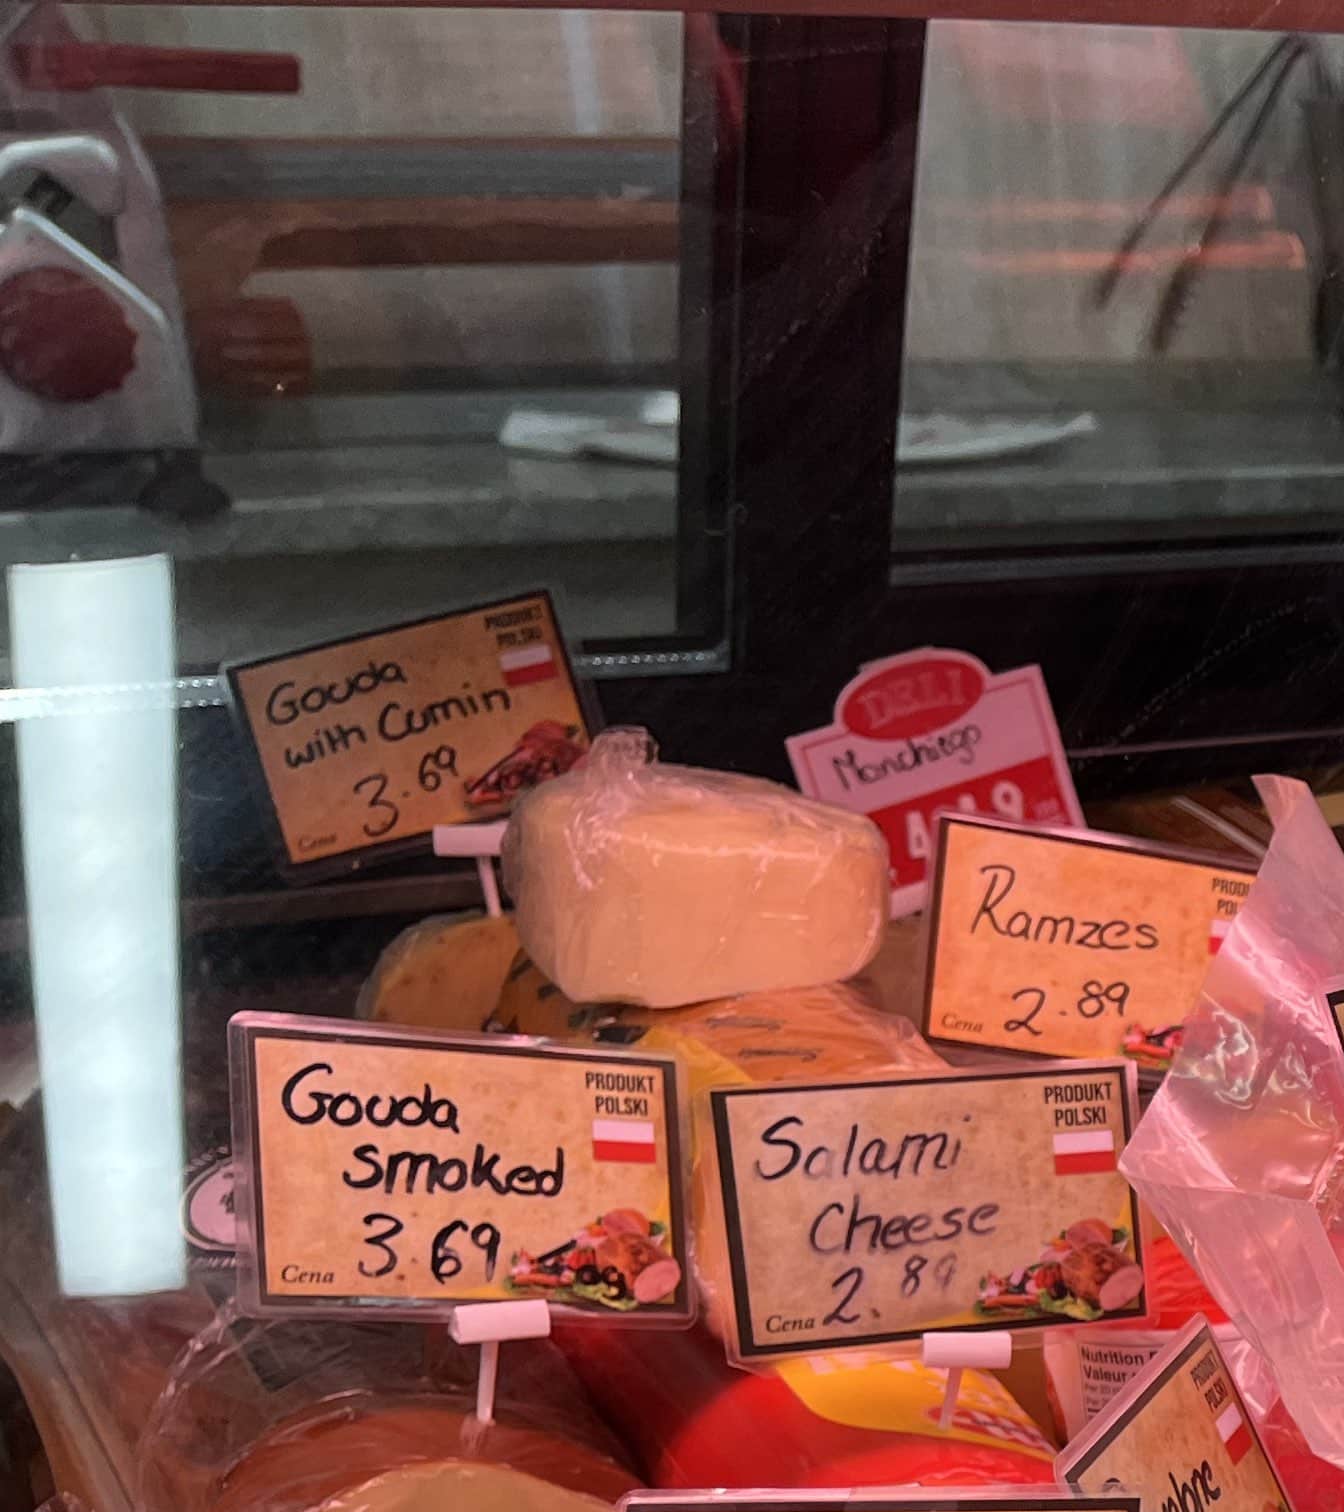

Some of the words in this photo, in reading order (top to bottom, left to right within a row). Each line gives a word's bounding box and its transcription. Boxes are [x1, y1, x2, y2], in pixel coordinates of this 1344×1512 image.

[265, 657, 409, 727] Gouda
[857, 666, 966, 730] DELI
[284, 722, 368, 770] with
[970, 863, 1161, 951] Ramzes
[1002, 980, 1132, 1037] 2.89
[940, 1012, 984, 1034] Cena
[585, 1072, 656, 1095] PRODUKT
[1044, 1081, 1113, 1105] PRODUKT
[281, 1063, 461, 1134] Gouda
[595, 1096, 650, 1118] POLSKI
[1054, 1107, 1107, 1127] POLSKI
[755, 1115, 972, 1181] Salami
[281, 1264, 335, 1285] Cena
[822, 1252, 957, 1327] 2.89
[764, 1312, 816, 1335] Cena
[1080, 1346, 1146, 1367] Nutrition
[1083, 1365, 1128, 1384] Valeur
